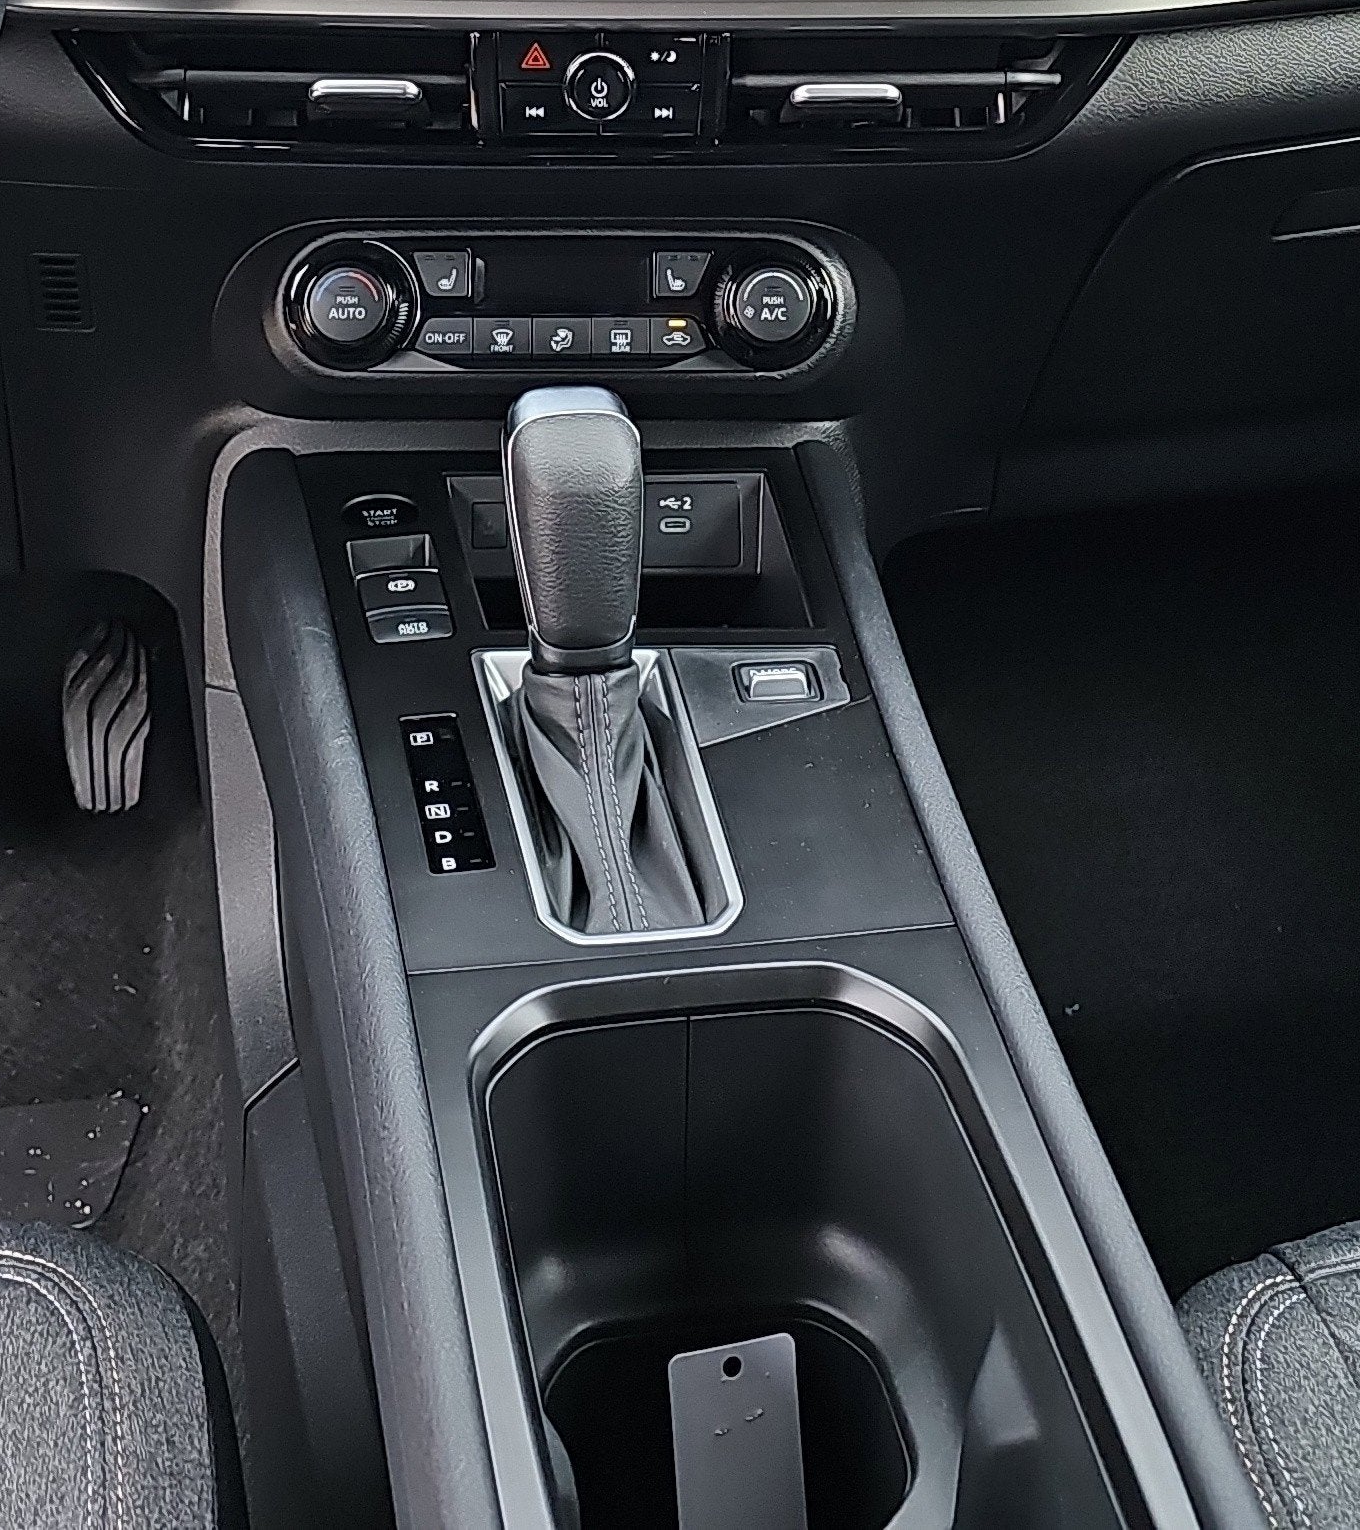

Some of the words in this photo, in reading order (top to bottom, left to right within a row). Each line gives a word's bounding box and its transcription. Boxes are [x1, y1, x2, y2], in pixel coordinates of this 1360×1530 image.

[590, 98, 609, 108] VOL
[335, 296, 359, 305] PUSH
[762, 296, 785, 305] PUSH
[328, 307, 366, 320] AUTO
[759, 306, 788, 321] A/C
[490, 344, 514, 353] FRONT
[611, 345, 631, 353] REAR
[682, 496, 693, 510] 2
[424, 780, 440, 793] R
[434, 830, 452, 844] D
[441, 857, 457, 871] B
